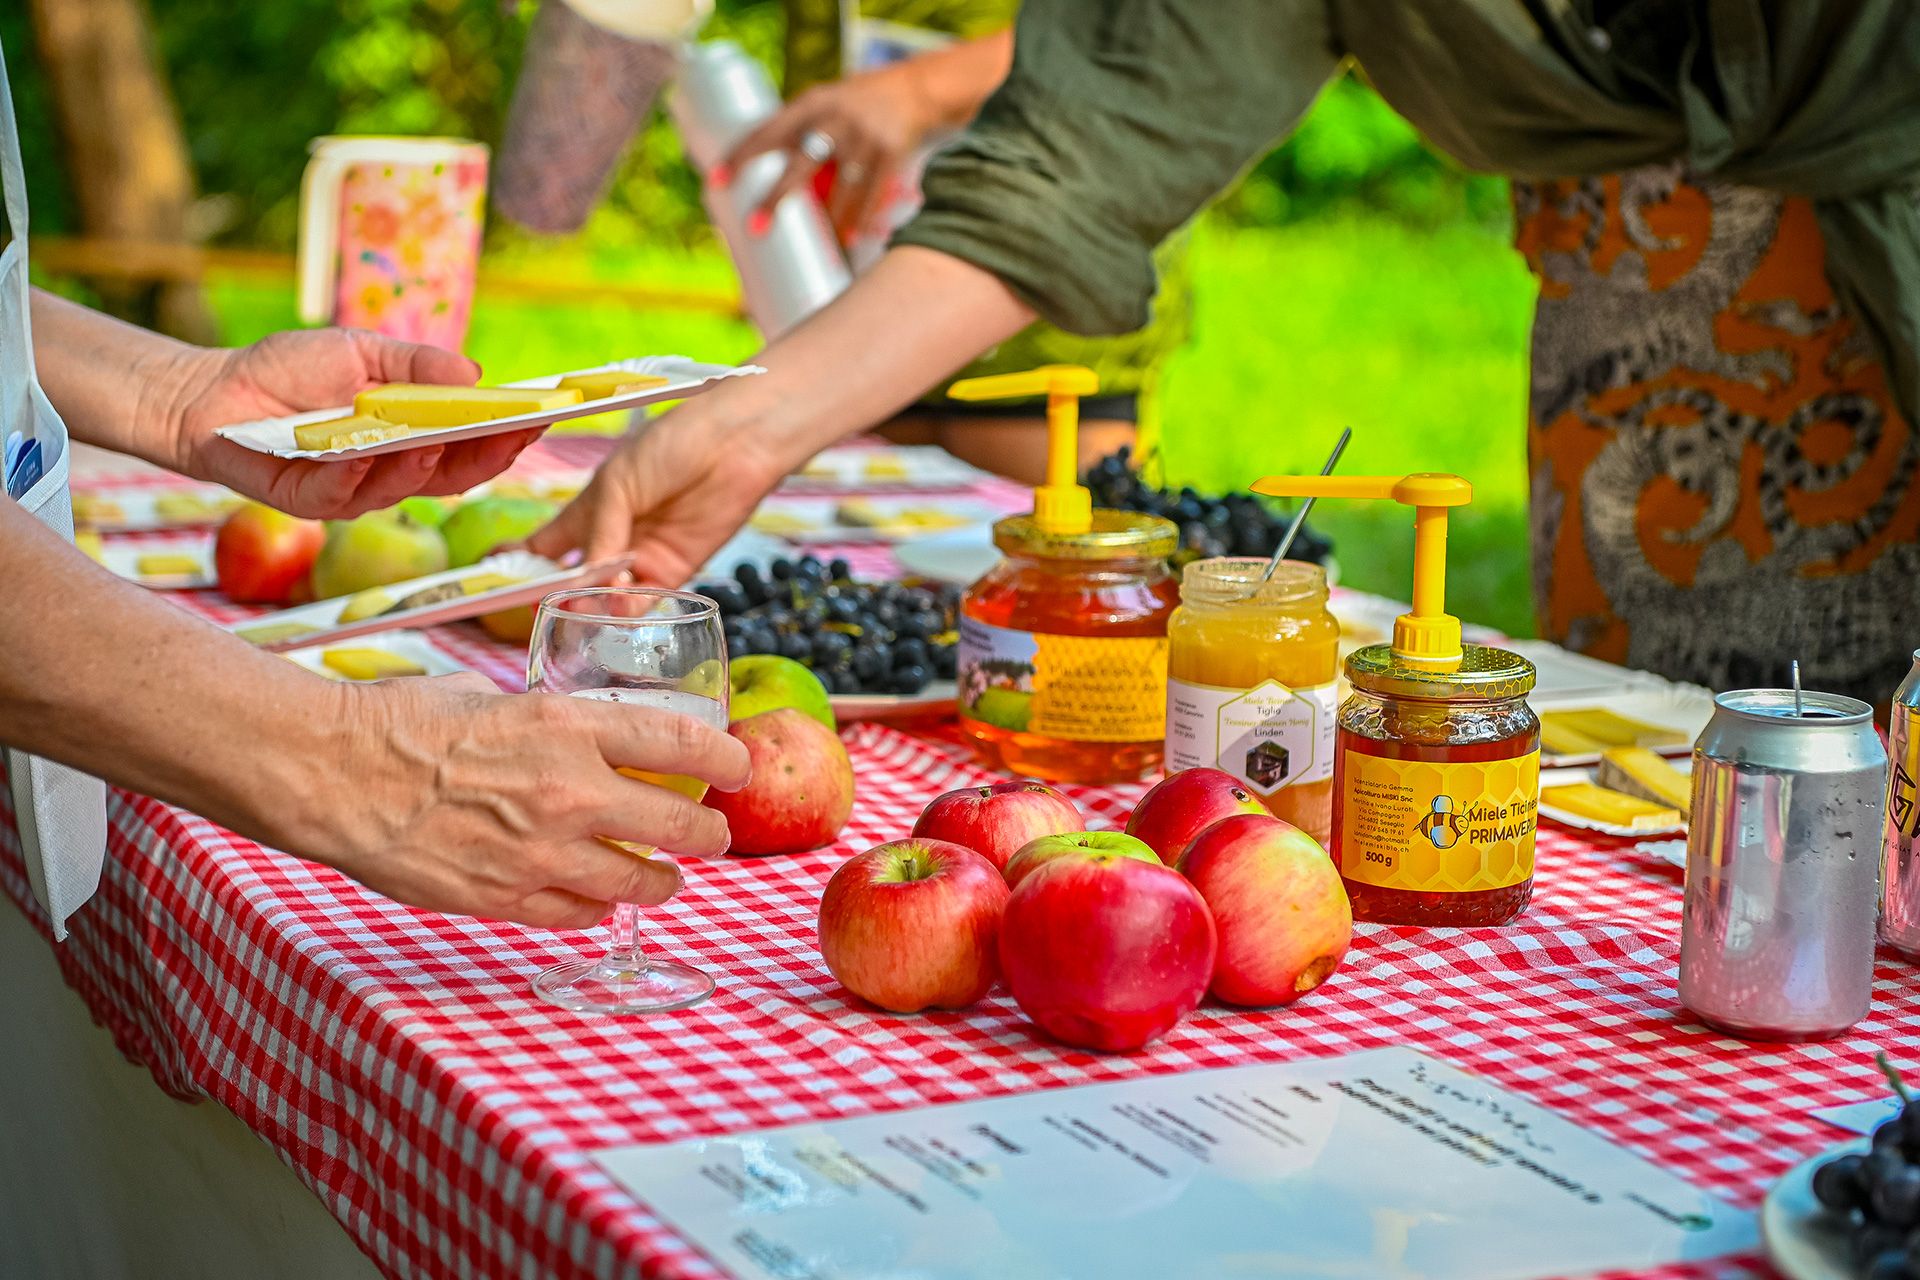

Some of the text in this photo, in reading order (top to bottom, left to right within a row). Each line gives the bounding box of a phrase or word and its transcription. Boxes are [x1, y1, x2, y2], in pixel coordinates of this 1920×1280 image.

[1254, 728, 1284, 737] Linden
[1400, 795, 1413, 803] Snc
[1393, 805, 1414, 813] Lurati
[1469, 806, 1508, 822] Miele
[1365, 851, 1393, 867] 500 g
